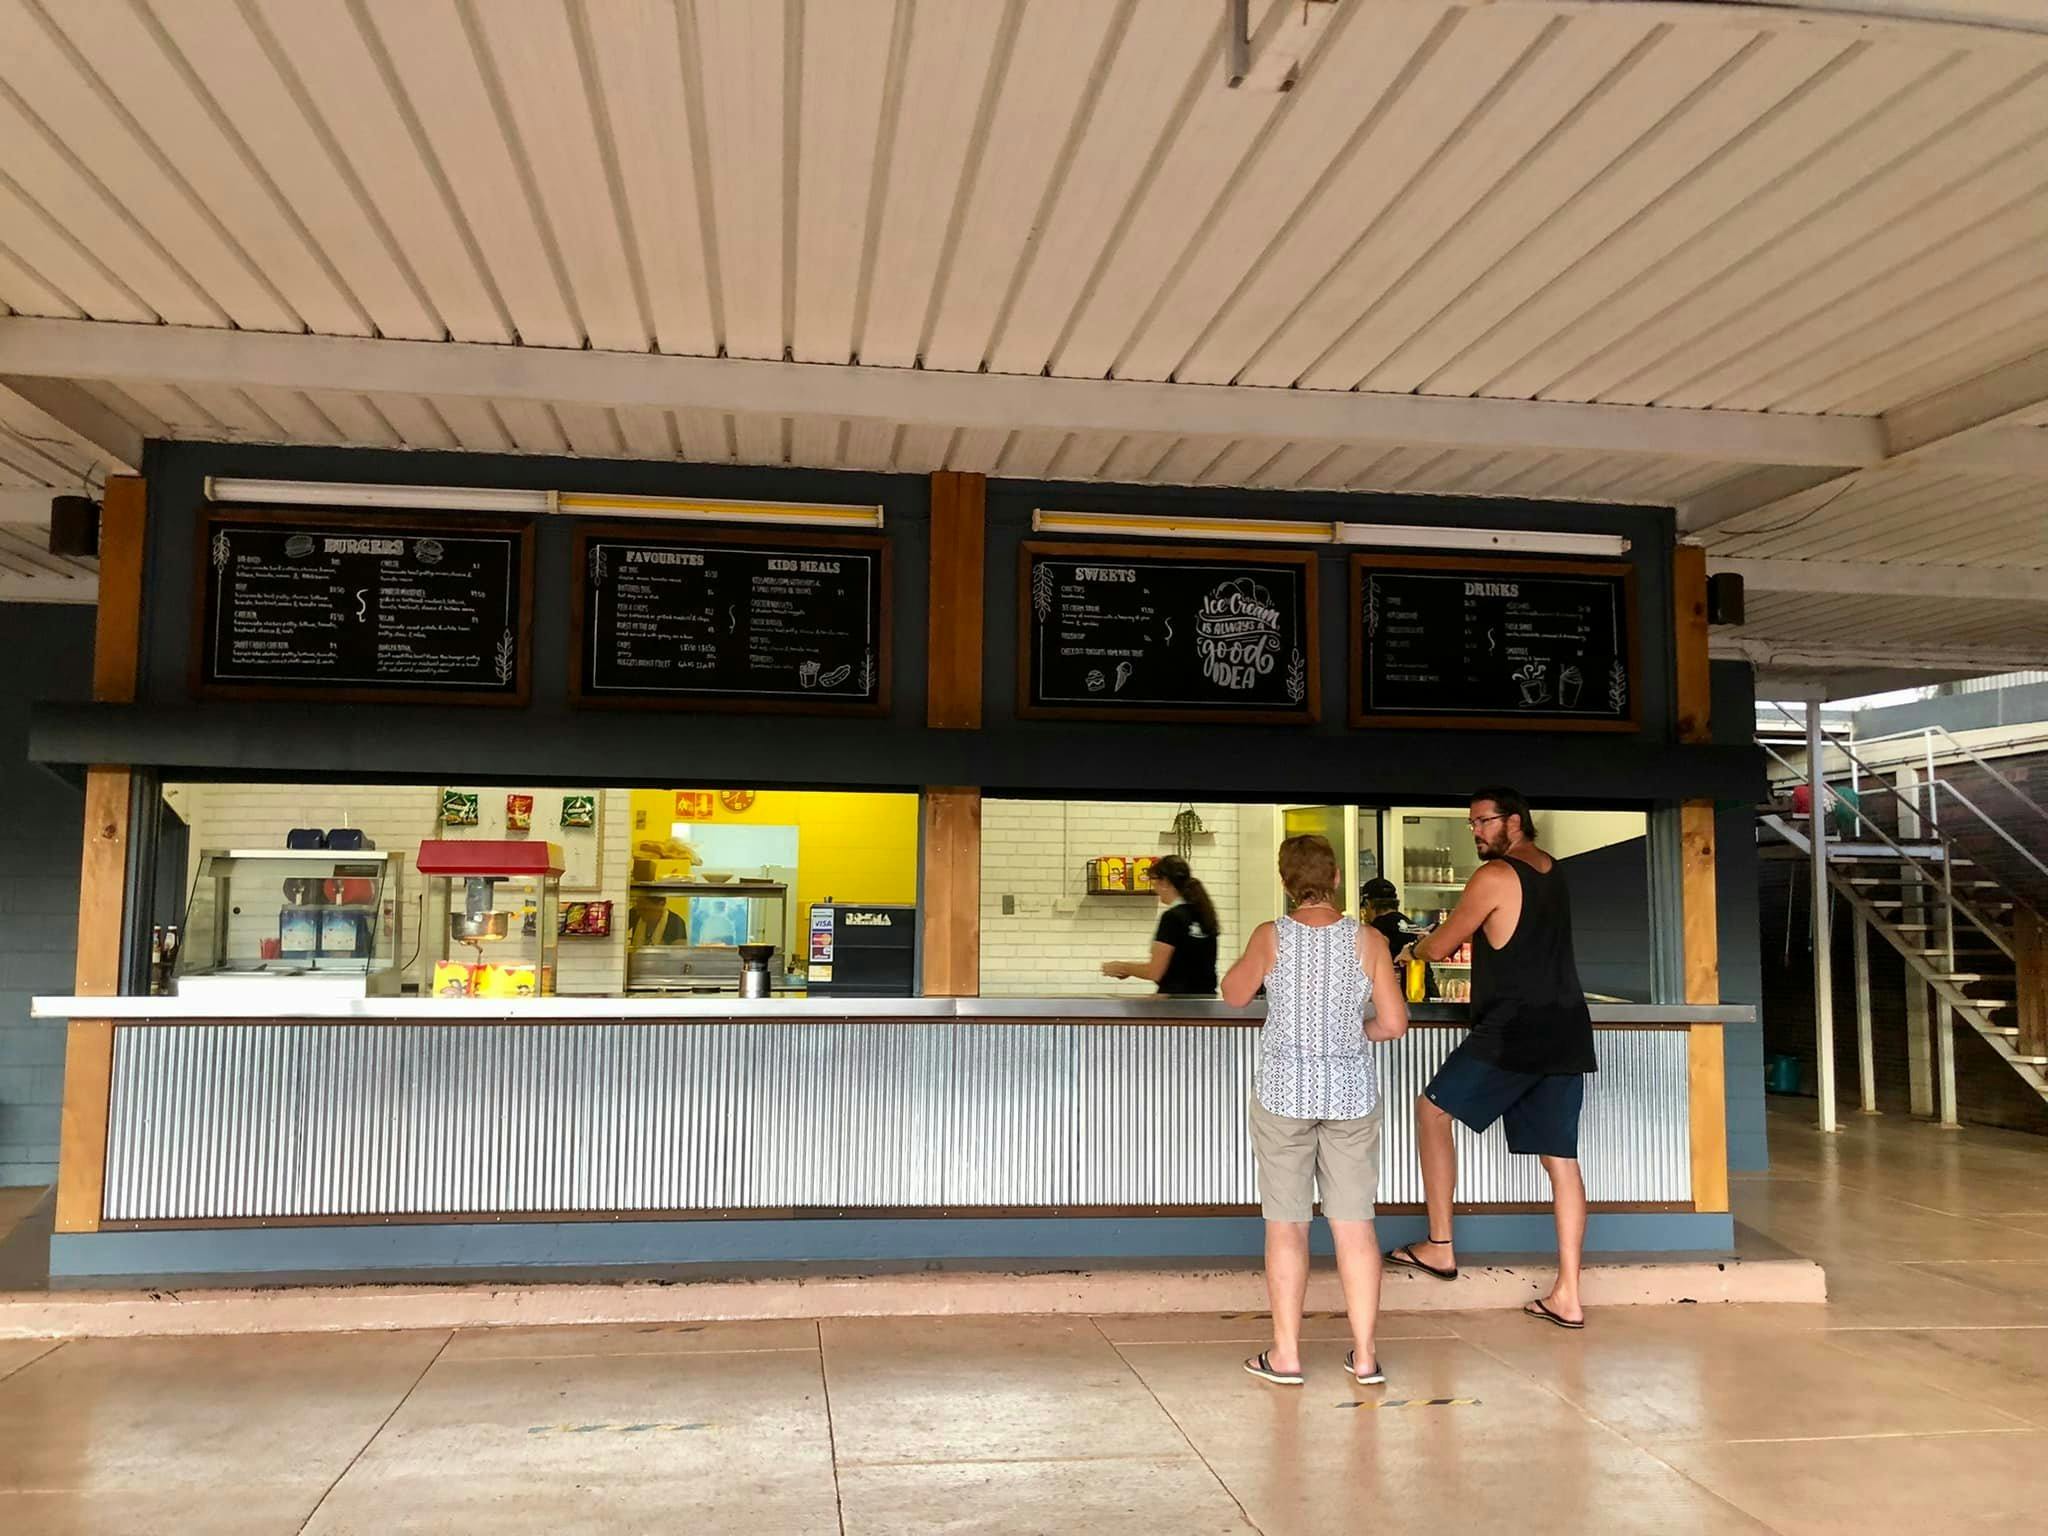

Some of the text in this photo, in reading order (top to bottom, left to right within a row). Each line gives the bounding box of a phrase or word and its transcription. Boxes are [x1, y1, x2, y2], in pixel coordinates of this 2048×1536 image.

[324, 539, 404, 556] BURGERS
[625, 550, 705, 567] FAVOURITES
[767, 559, 841, 574] KIDS MEALS
[1075, 567, 1136, 583] SWEETS
[1463, 582, 1520, 598] DRINKS
[1203, 593, 1280, 629] Ice Cream
[1202, 621, 1265, 635] IS ALWAYS A
[1201, 634, 1275, 678] good
[1212, 661, 1256, 689] IDEA
[816, 920, 832, 928] VISA
